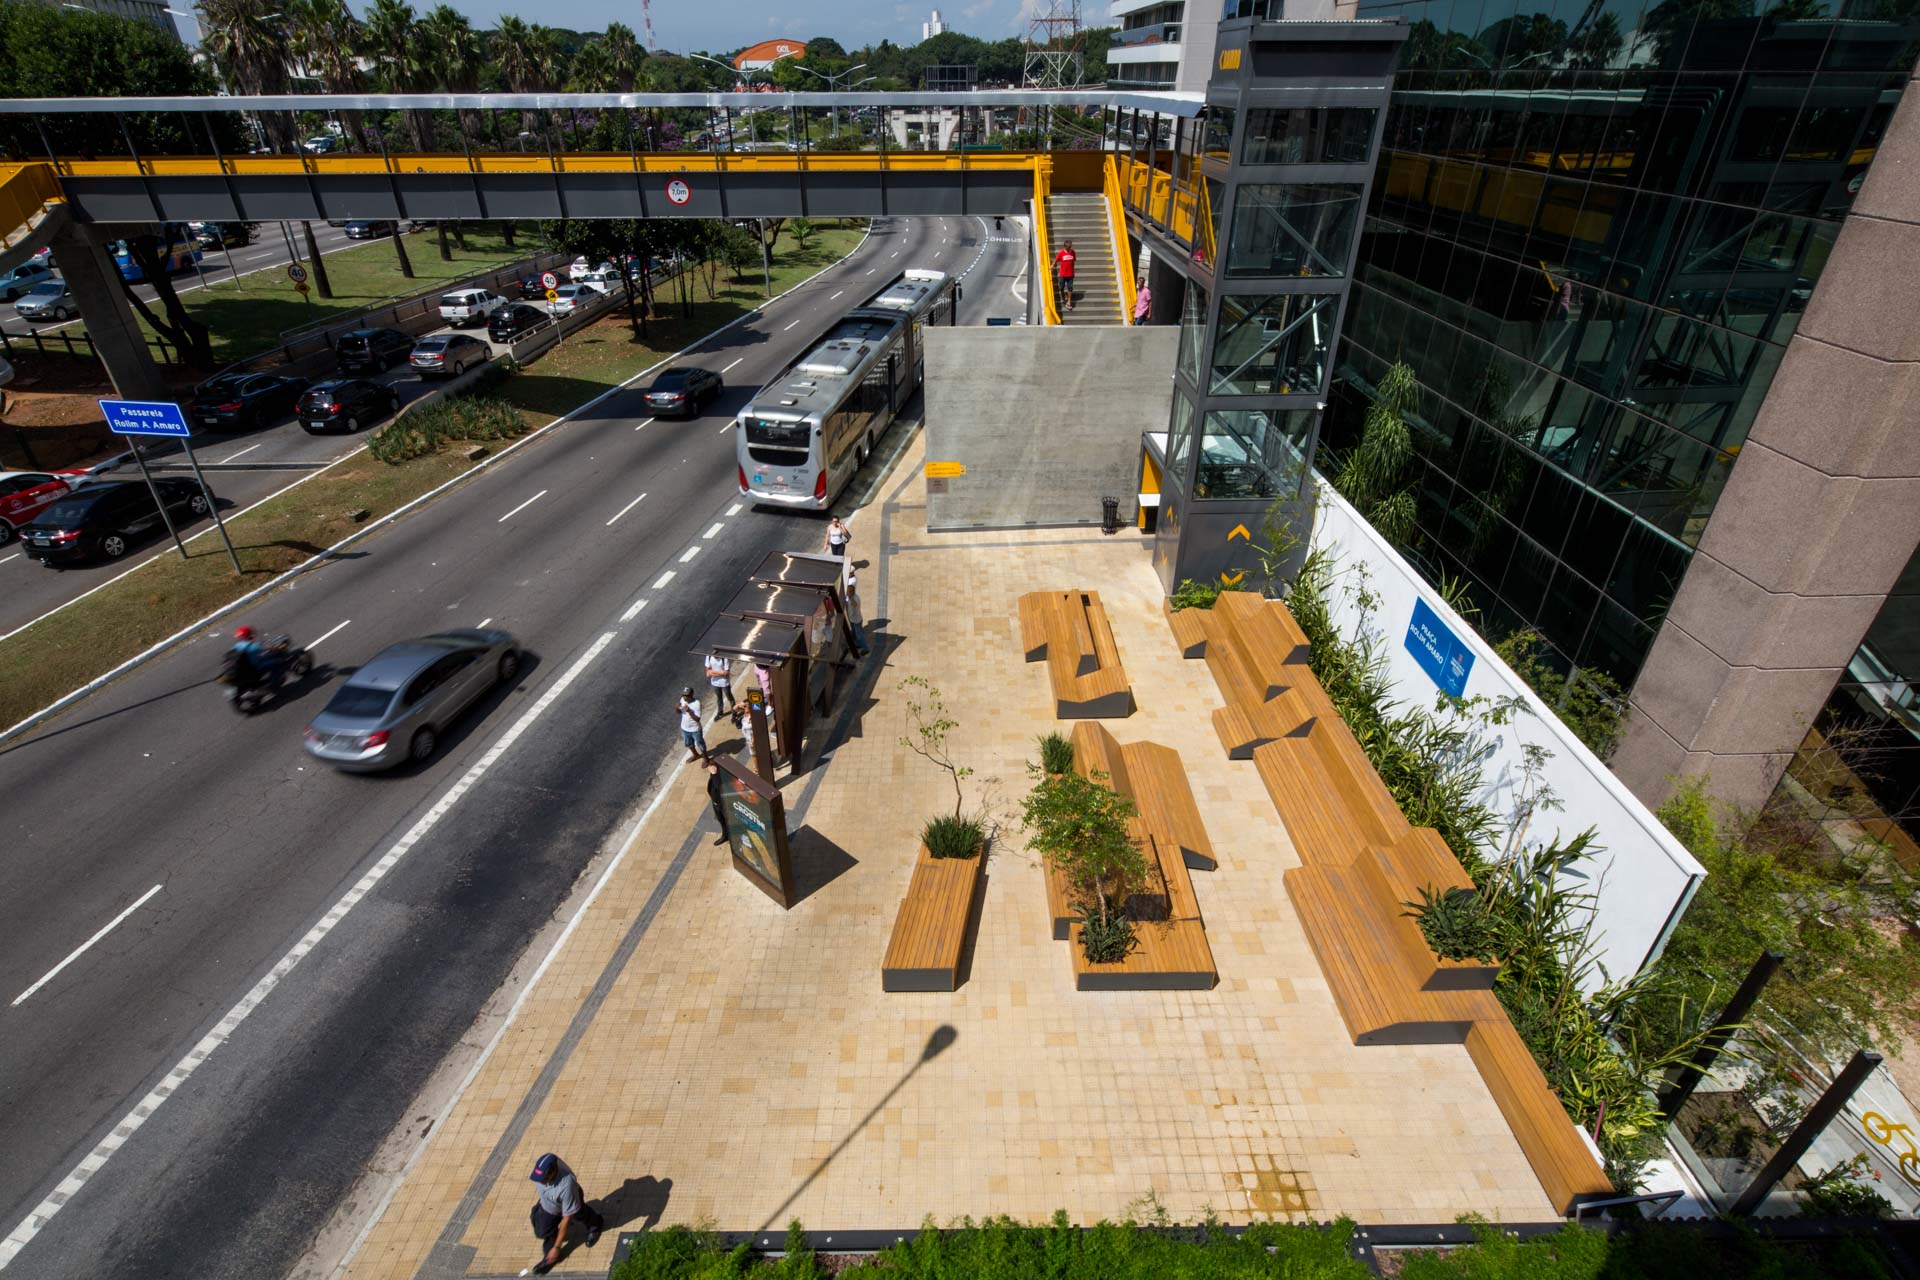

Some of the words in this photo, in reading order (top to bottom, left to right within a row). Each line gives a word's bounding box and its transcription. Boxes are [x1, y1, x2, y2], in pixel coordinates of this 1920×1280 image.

[776, 45, 790, 53] GOL
[291, 267, 305, 278] 40
[545, 276, 555, 285] 40
[120, 407, 164, 418] Passarela
[113, 419, 139, 428] Rolim
[153, 421, 181, 431] Amaro
[1421, 624, 1437, 646] PRAÇA
[1409, 624, 1427, 646] ROLIM
[1425, 641, 1444, 665] AMARO
